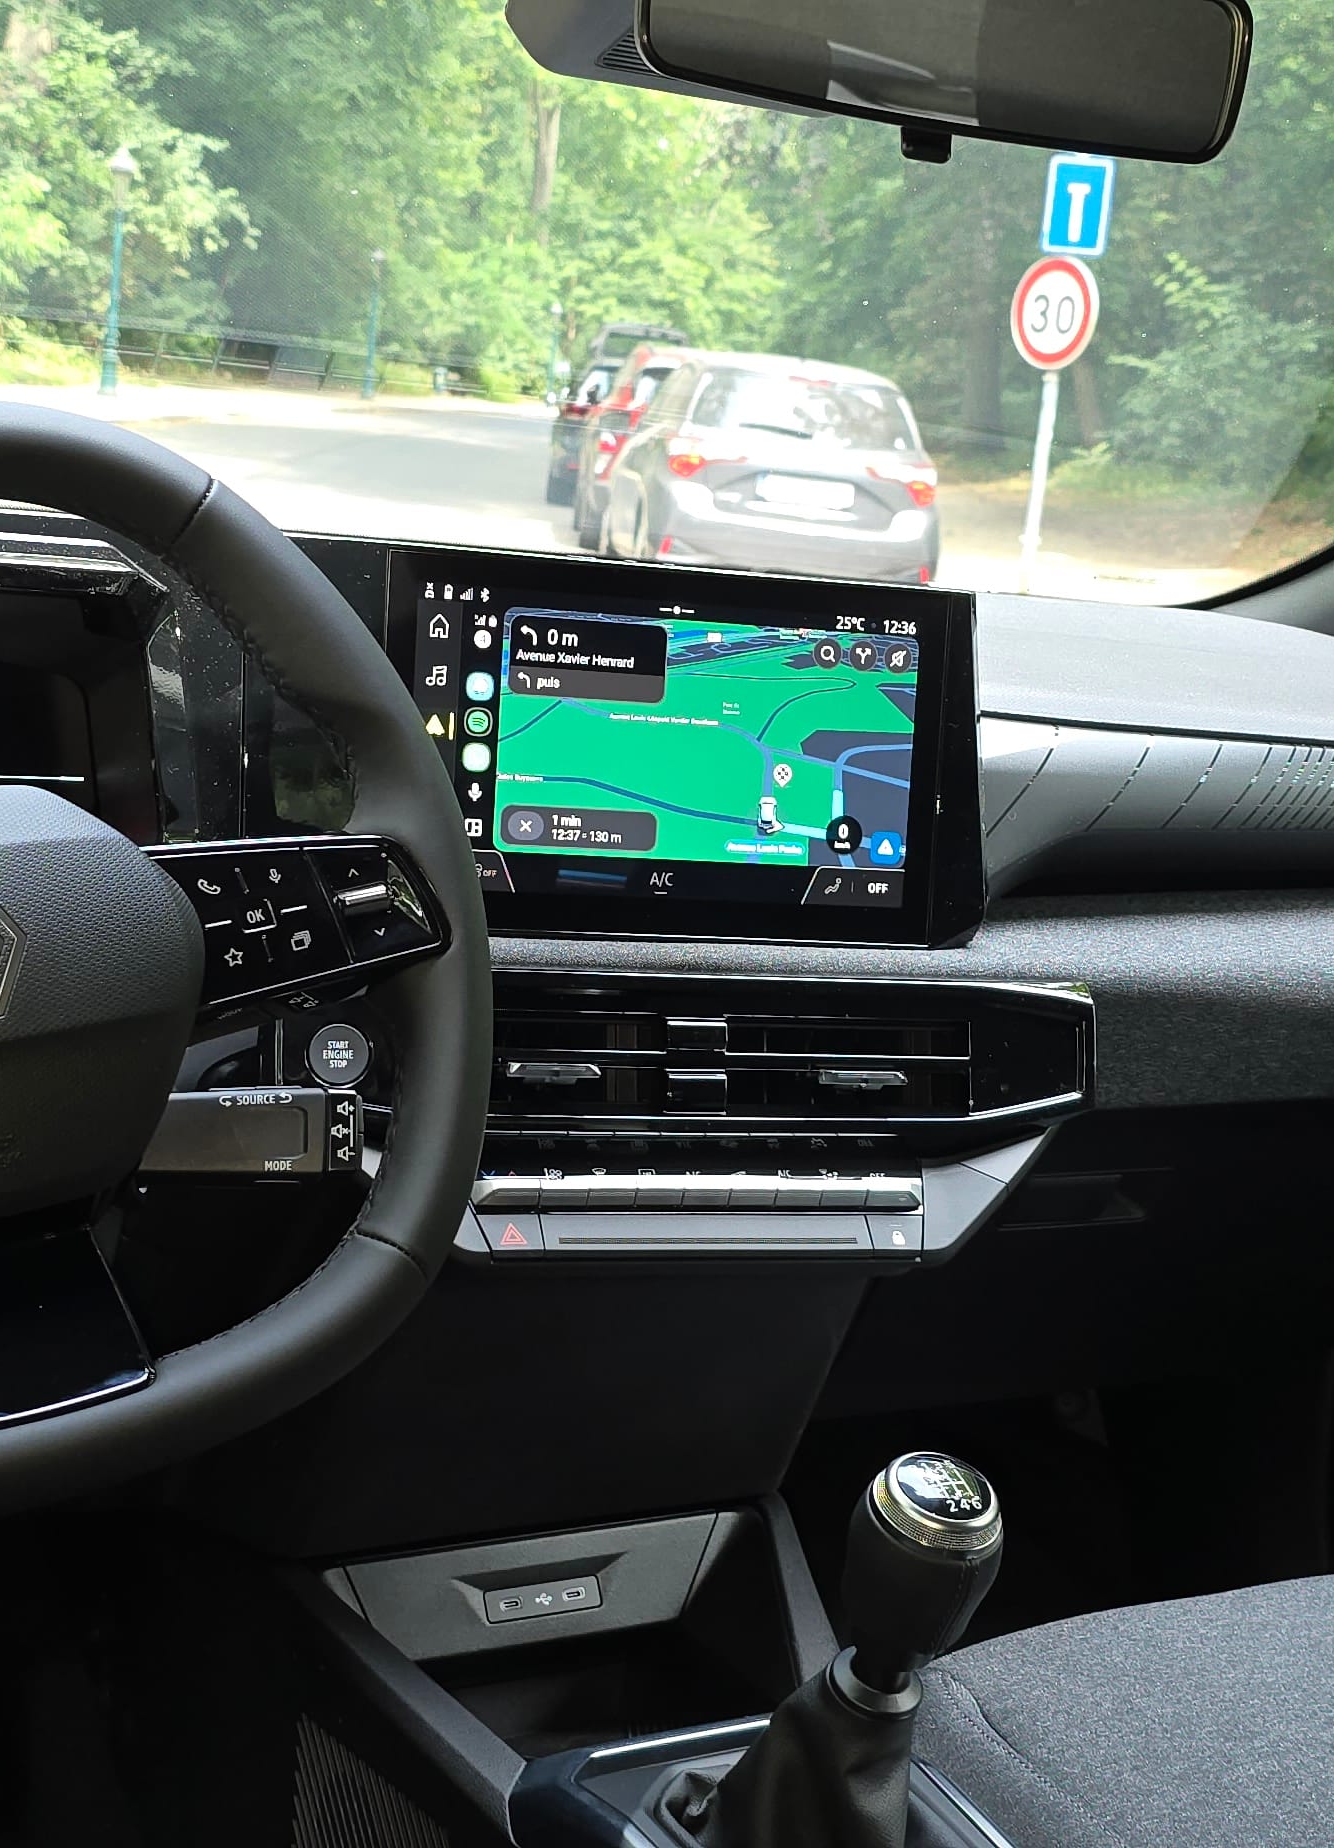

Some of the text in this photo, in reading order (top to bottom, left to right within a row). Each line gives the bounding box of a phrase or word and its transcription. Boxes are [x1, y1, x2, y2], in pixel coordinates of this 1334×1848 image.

[1031, 294, 1075, 334] 30
[883, 620, 917, 635] 12:36
[547, 628, 579, 648] 0 m
[516, 649, 556, 664] Avenue
[557, 651, 591, 666] Xavier
[536, 675, 561, 690] puis
[552, 814, 582, 827] 1 min
[551, 828, 622, 844] 12:37 130 m
[838, 824, 849, 839] 0
[649, 872, 674, 887] A/C
[867, 882, 889, 894] OFF
[246, 909, 266, 924] OK
[327, 1040, 349, 1049] START
[322, 1050, 354, 1060] ENGINE
[329, 1059, 348, 1068] STOP
[236, 1094, 276, 1106] SOURCE
[264, 1160, 293, 1171] MODE
